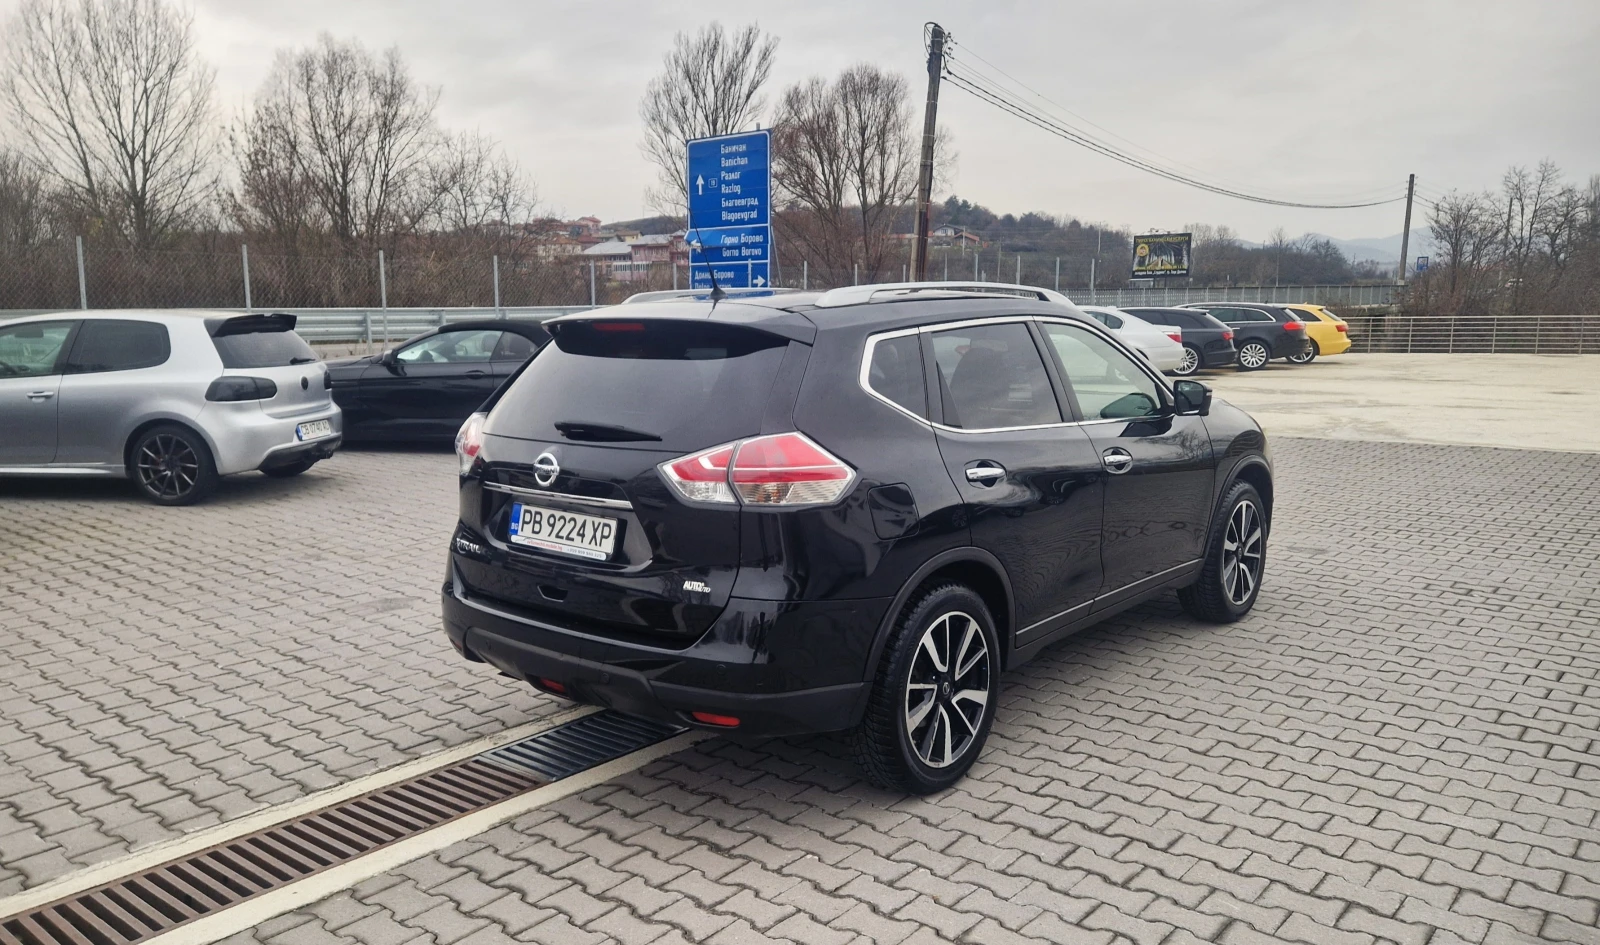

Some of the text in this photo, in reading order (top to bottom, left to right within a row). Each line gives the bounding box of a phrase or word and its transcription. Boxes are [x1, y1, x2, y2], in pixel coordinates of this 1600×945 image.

[720, 144, 747, 154] Баничан
[720, 156, 748, 167] Banichan
[720, 171, 741, 180] Разлог
[721, 183, 741, 194] Razlog
[721, 197, 759, 208] Благоевград
[721, 209, 758, 222] Blagoevgrad
[720, 234, 764, 246] Горно Борово
[722, 247, 762, 257] Gorno Borovo
[714, 270, 734, 280] Борово
[520, 508, 612, 548] PB 9224 XP
